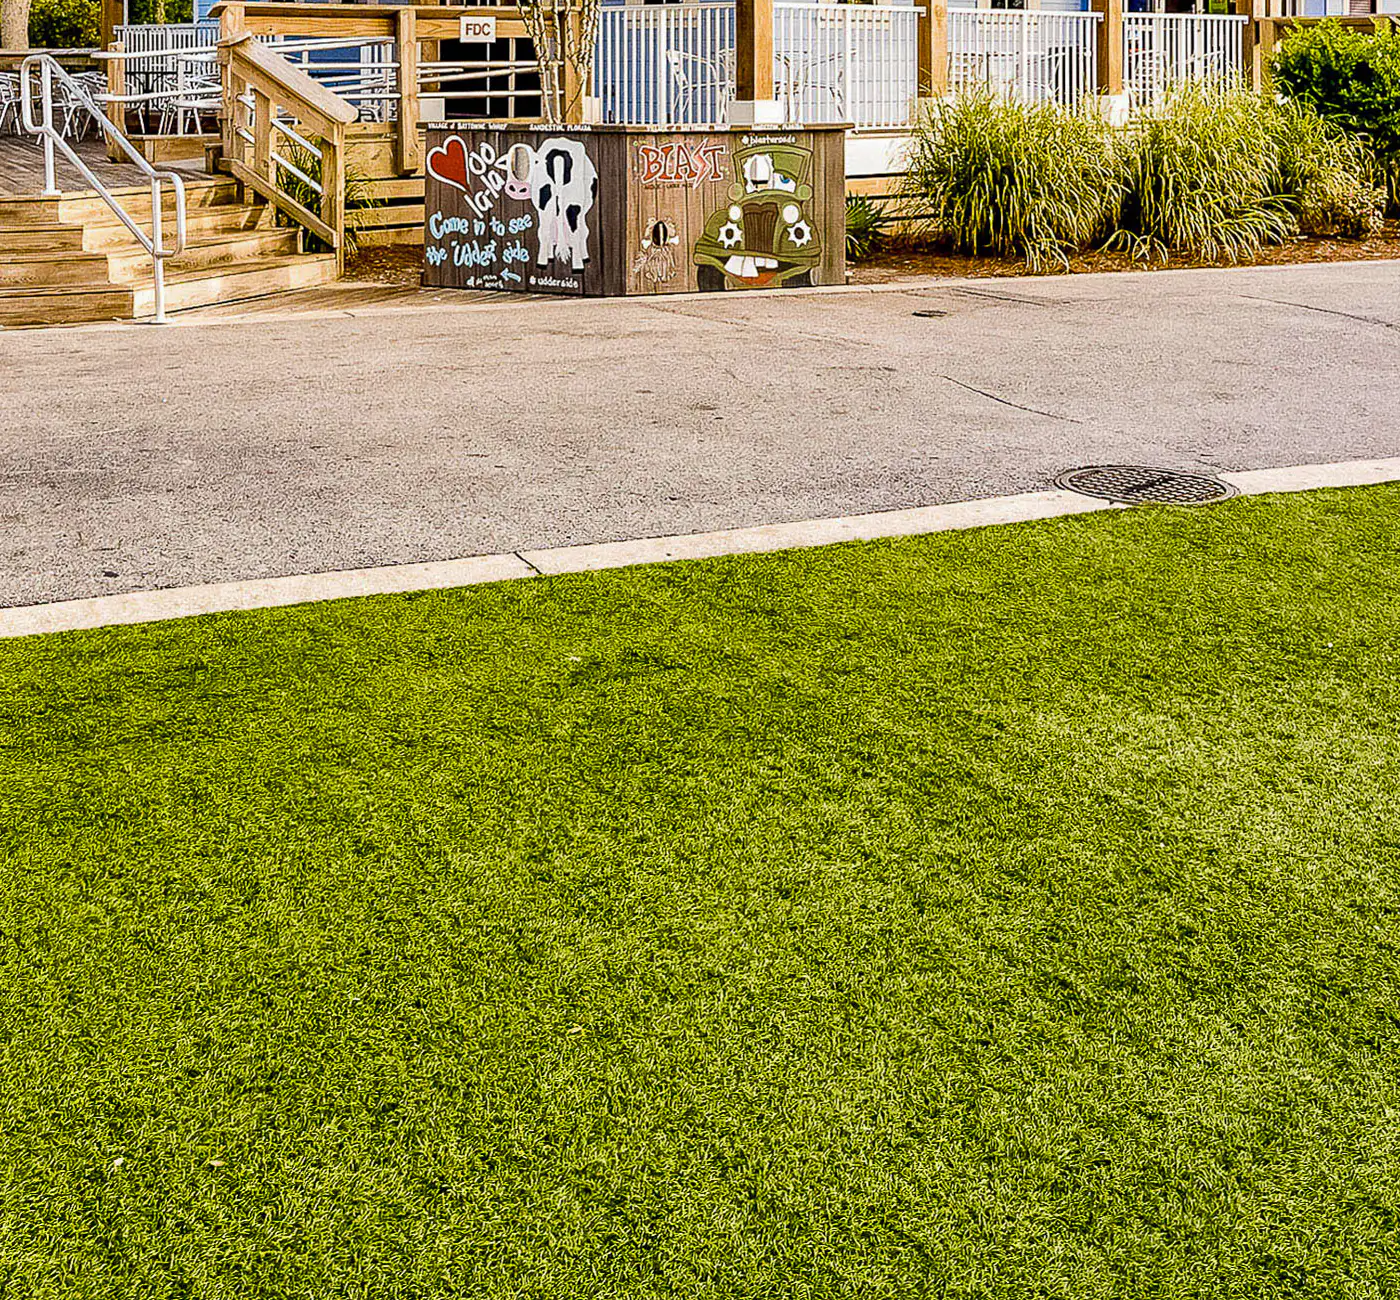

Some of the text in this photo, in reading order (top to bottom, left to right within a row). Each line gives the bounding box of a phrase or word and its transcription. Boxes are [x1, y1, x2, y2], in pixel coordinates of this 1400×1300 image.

[465, 22, 491, 36] FDC
[640, 138, 725, 189] BLAST
[429, 211, 533, 239] Come in to see
[426, 245, 448, 266] the
[502, 240, 530, 264] side
